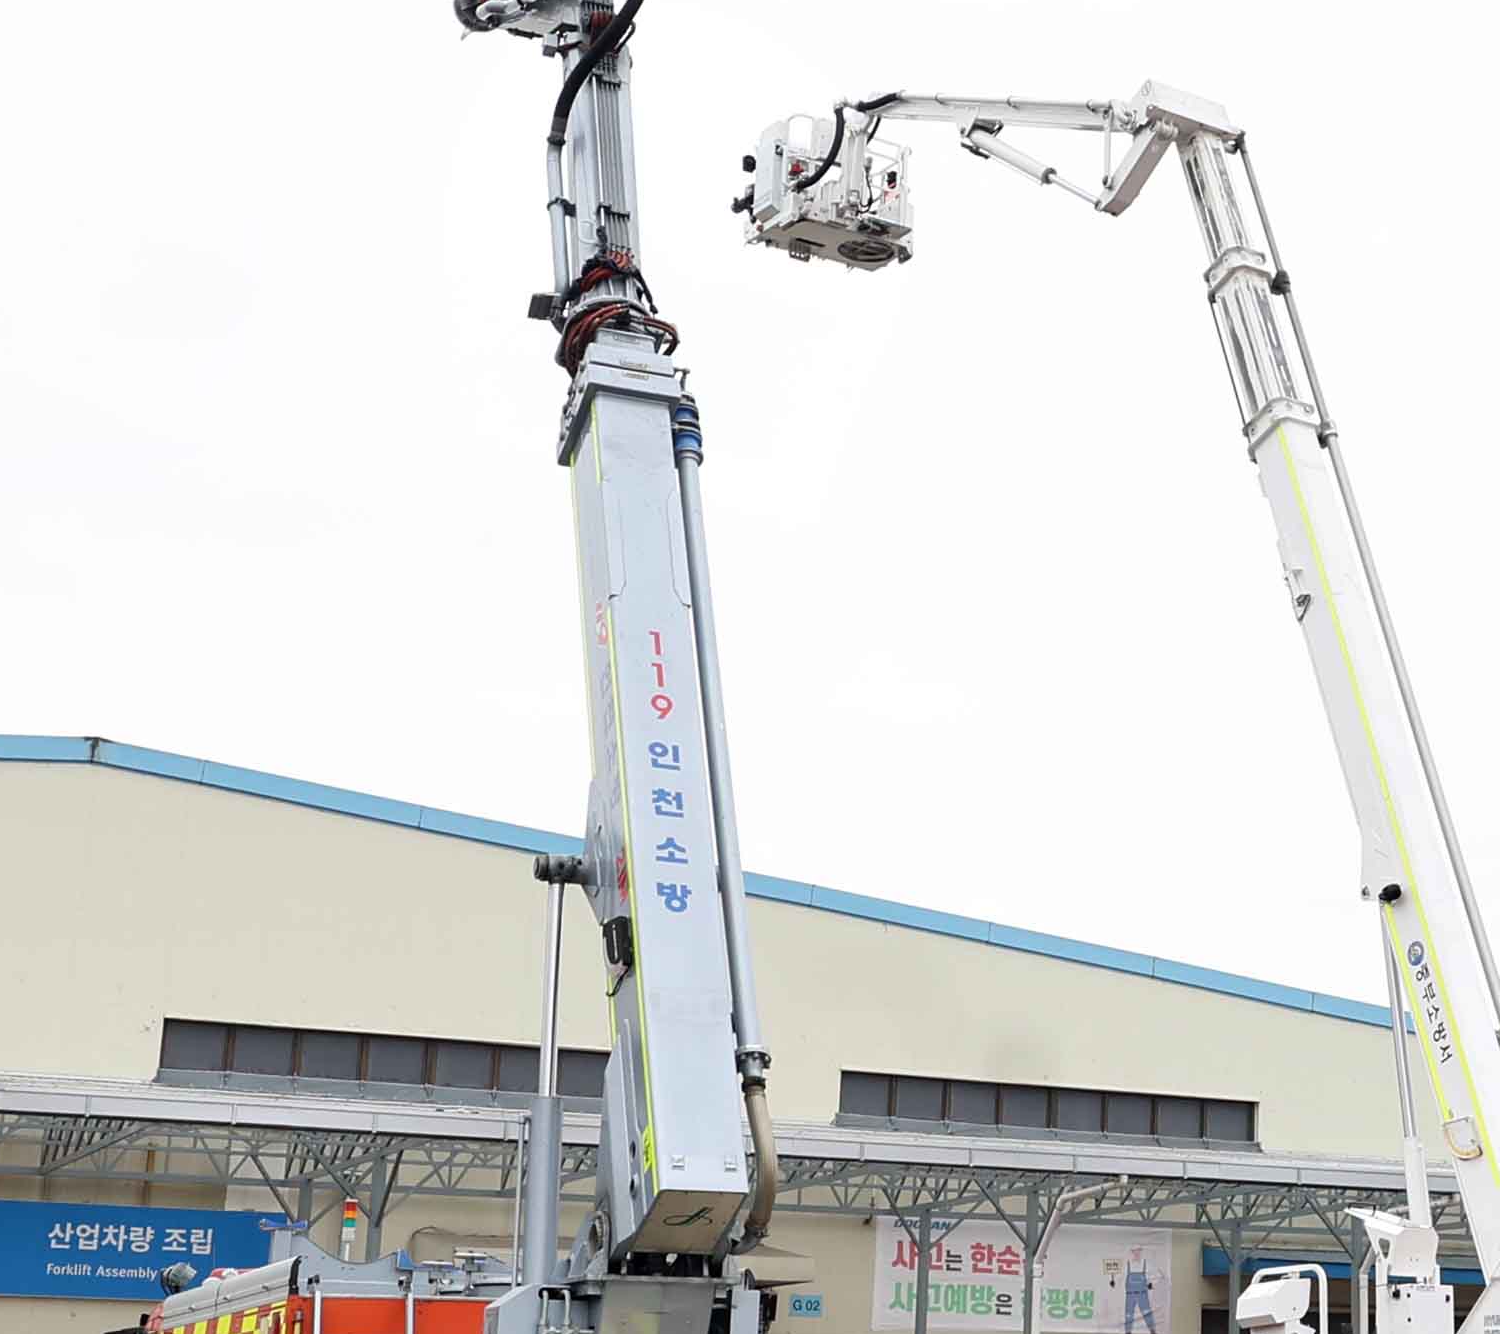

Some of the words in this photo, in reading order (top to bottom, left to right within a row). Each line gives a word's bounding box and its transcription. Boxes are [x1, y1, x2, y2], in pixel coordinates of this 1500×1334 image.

[648, 630, 673, 720] 119
[648, 741, 693, 914] 인천소방
[1416, 963, 1453, 1063] 중부소방서
[48, 1222, 155, 1253] 산업차량
[161, 1228, 213, 1255] 조립
[894, 1219, 952, 1231] DOOAN
[46, 1263, 92, 1276] Forklift
[95, 1265, 159, 1282] Assembly
[970, 1242, 1045, 1276] 한순
[793, 1298, 802, 1312] G
[805, 1299, 821, 1312] 02
